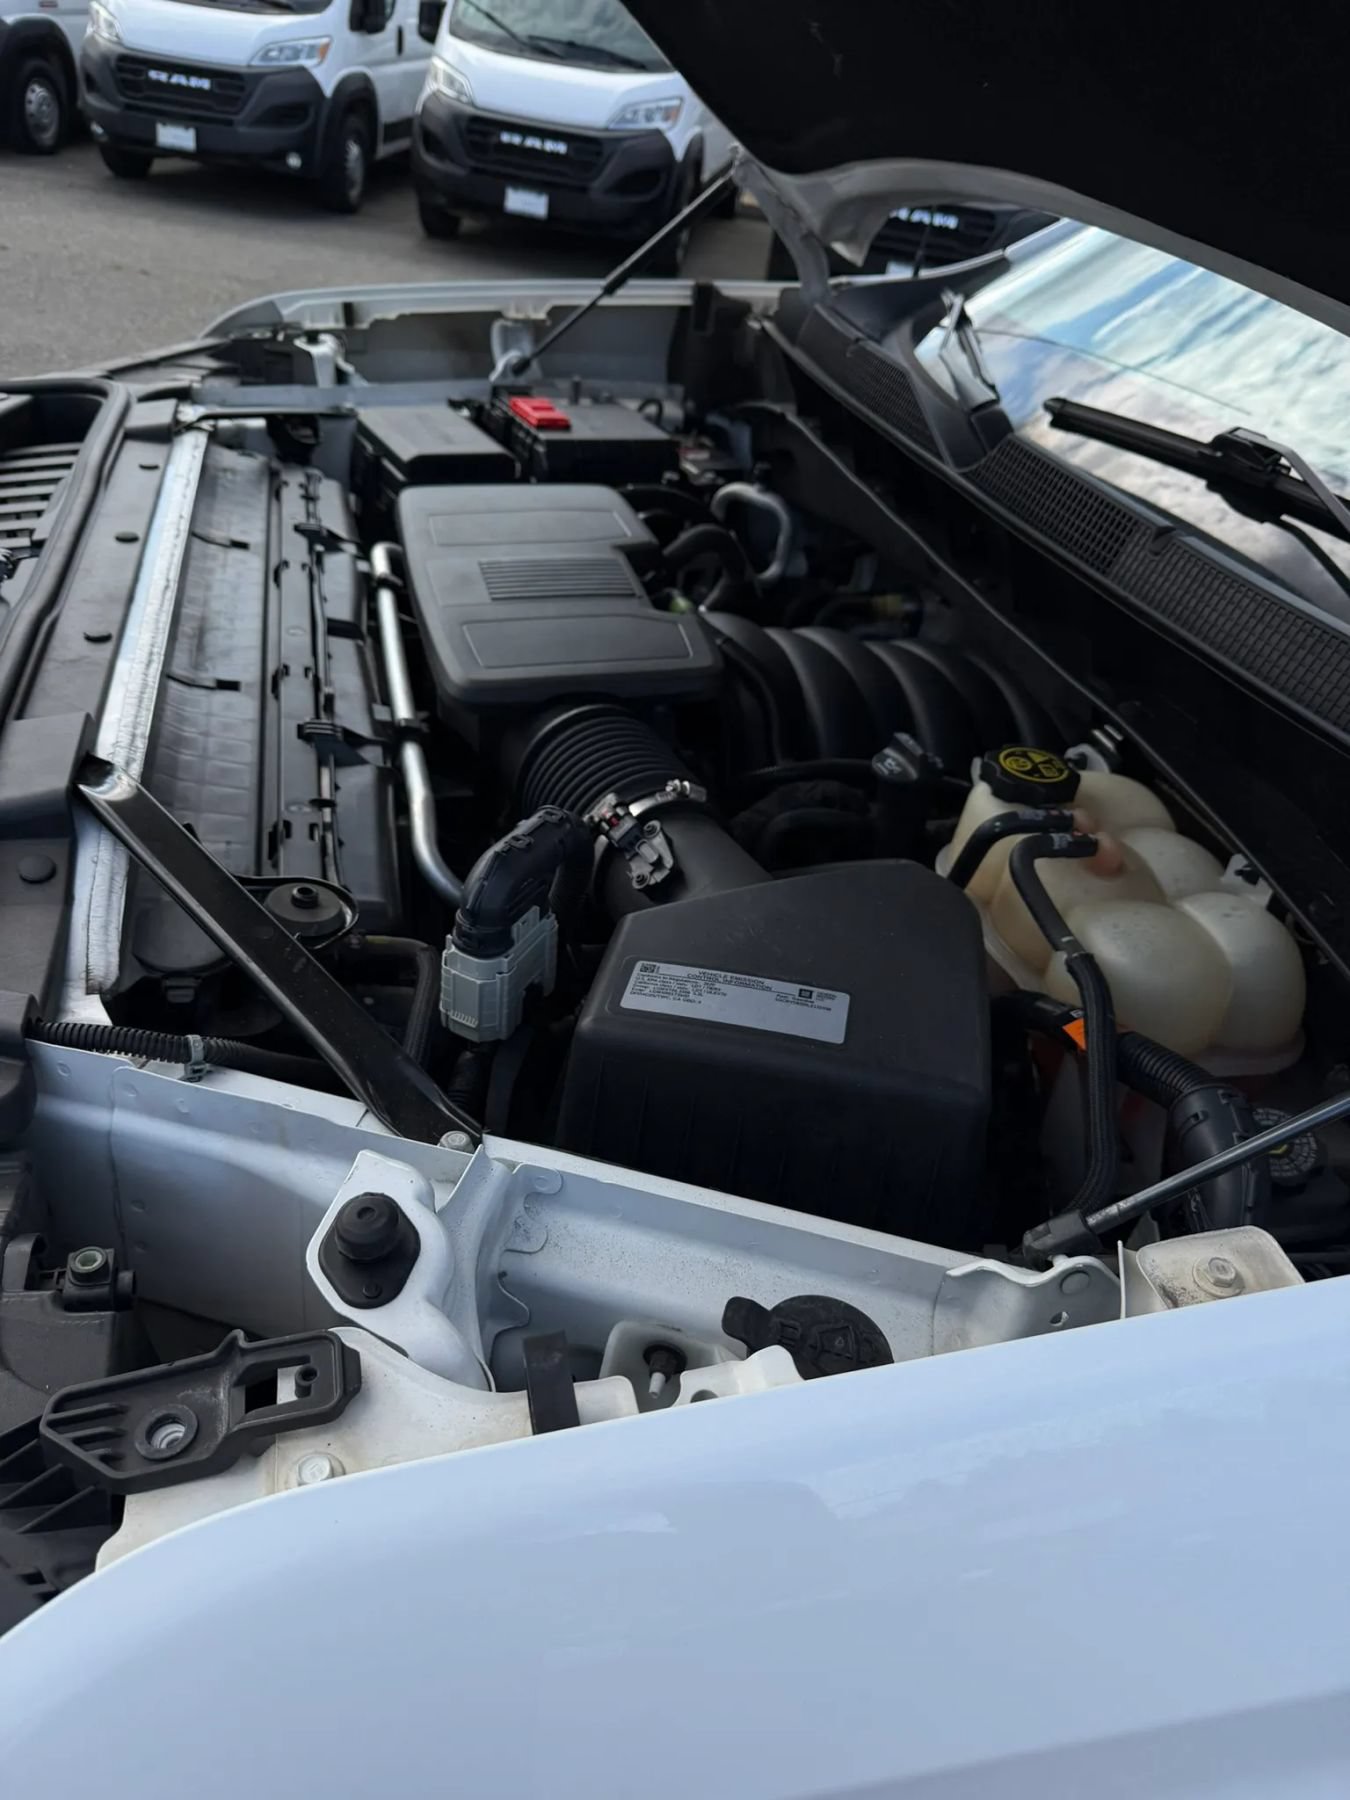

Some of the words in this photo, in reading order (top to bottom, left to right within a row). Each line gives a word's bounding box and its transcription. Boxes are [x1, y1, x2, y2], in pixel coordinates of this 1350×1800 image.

[147, 69, 211, 90] RAM
[499, 130, 568, 155] RAM
[687, 973, 721, 984] CONTROL
[723, 978, 773, 991] INFORMATION
[698, 970, 728, 980] VEHICLE
[730, 975, 765, 985] EMISSION
